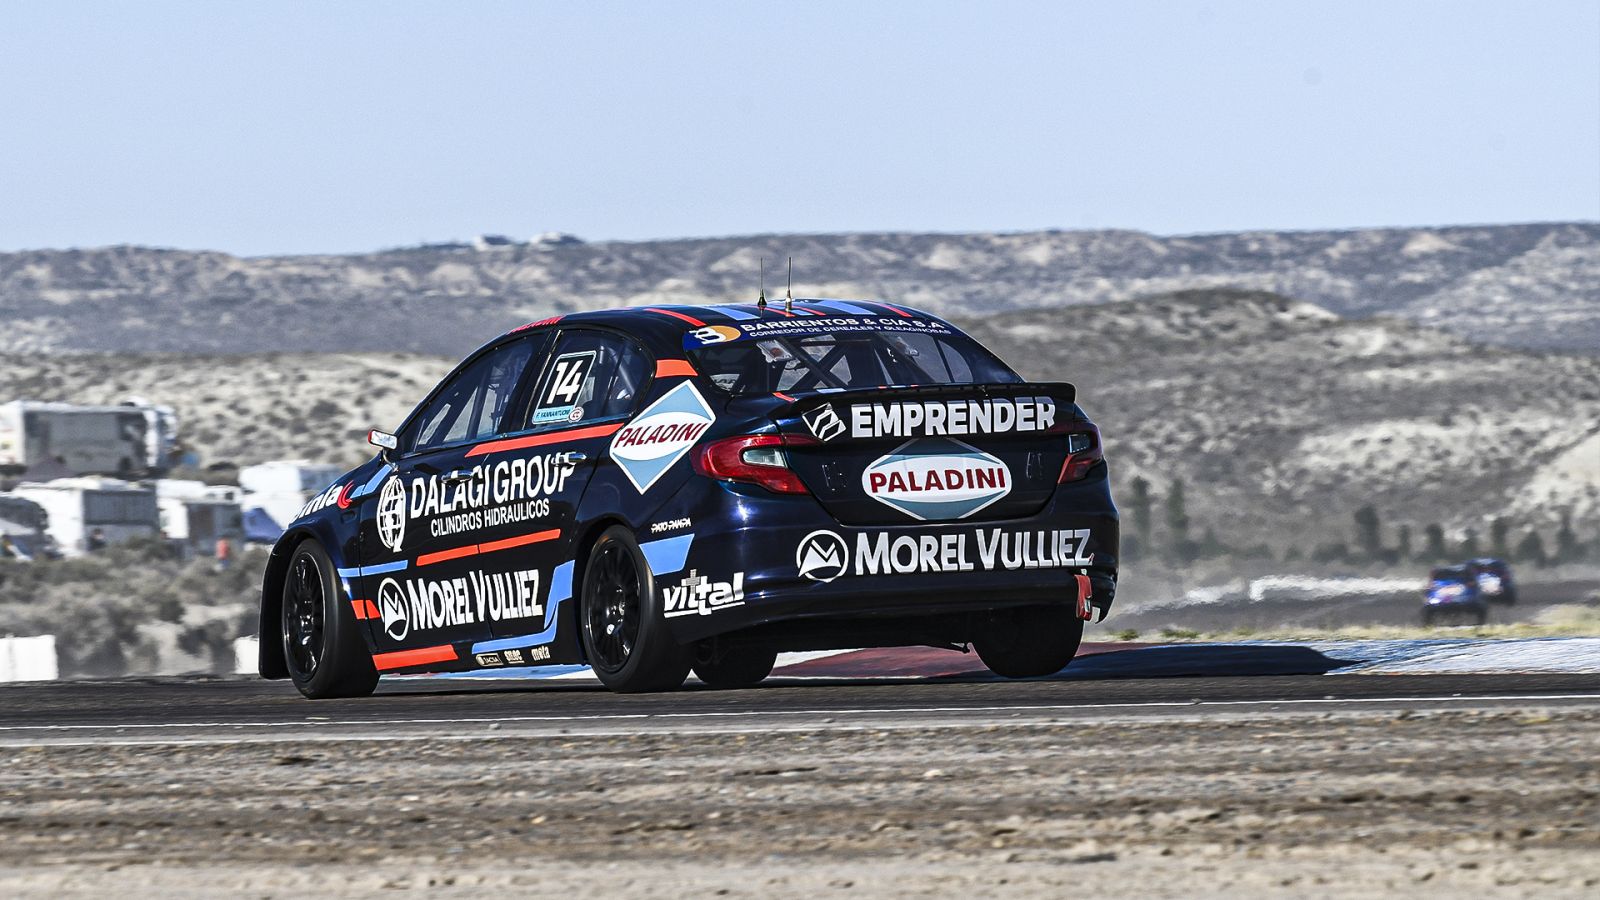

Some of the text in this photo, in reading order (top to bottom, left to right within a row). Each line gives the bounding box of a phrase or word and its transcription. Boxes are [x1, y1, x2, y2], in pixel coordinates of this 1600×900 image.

[740, 318, 860, 332] BARRIENTOS
[862, 318, 877, 326] &
[879, 318, 912, 327] CIA
[749, 327, 808, 337] CORREDOR
[546, 360, 584, 405] 14
[613, 423, 708, 449] PALADINI
[851, 397, 1056, 438] EMPRENDER
[410, 451, 577, 519] DALAGI GROUP
[869, 467, 1006, 493] PALADINI
[431, 497, 550, 537] CILINDROS HIDRAULICOS
[662, 569, 744, 616] vittal
